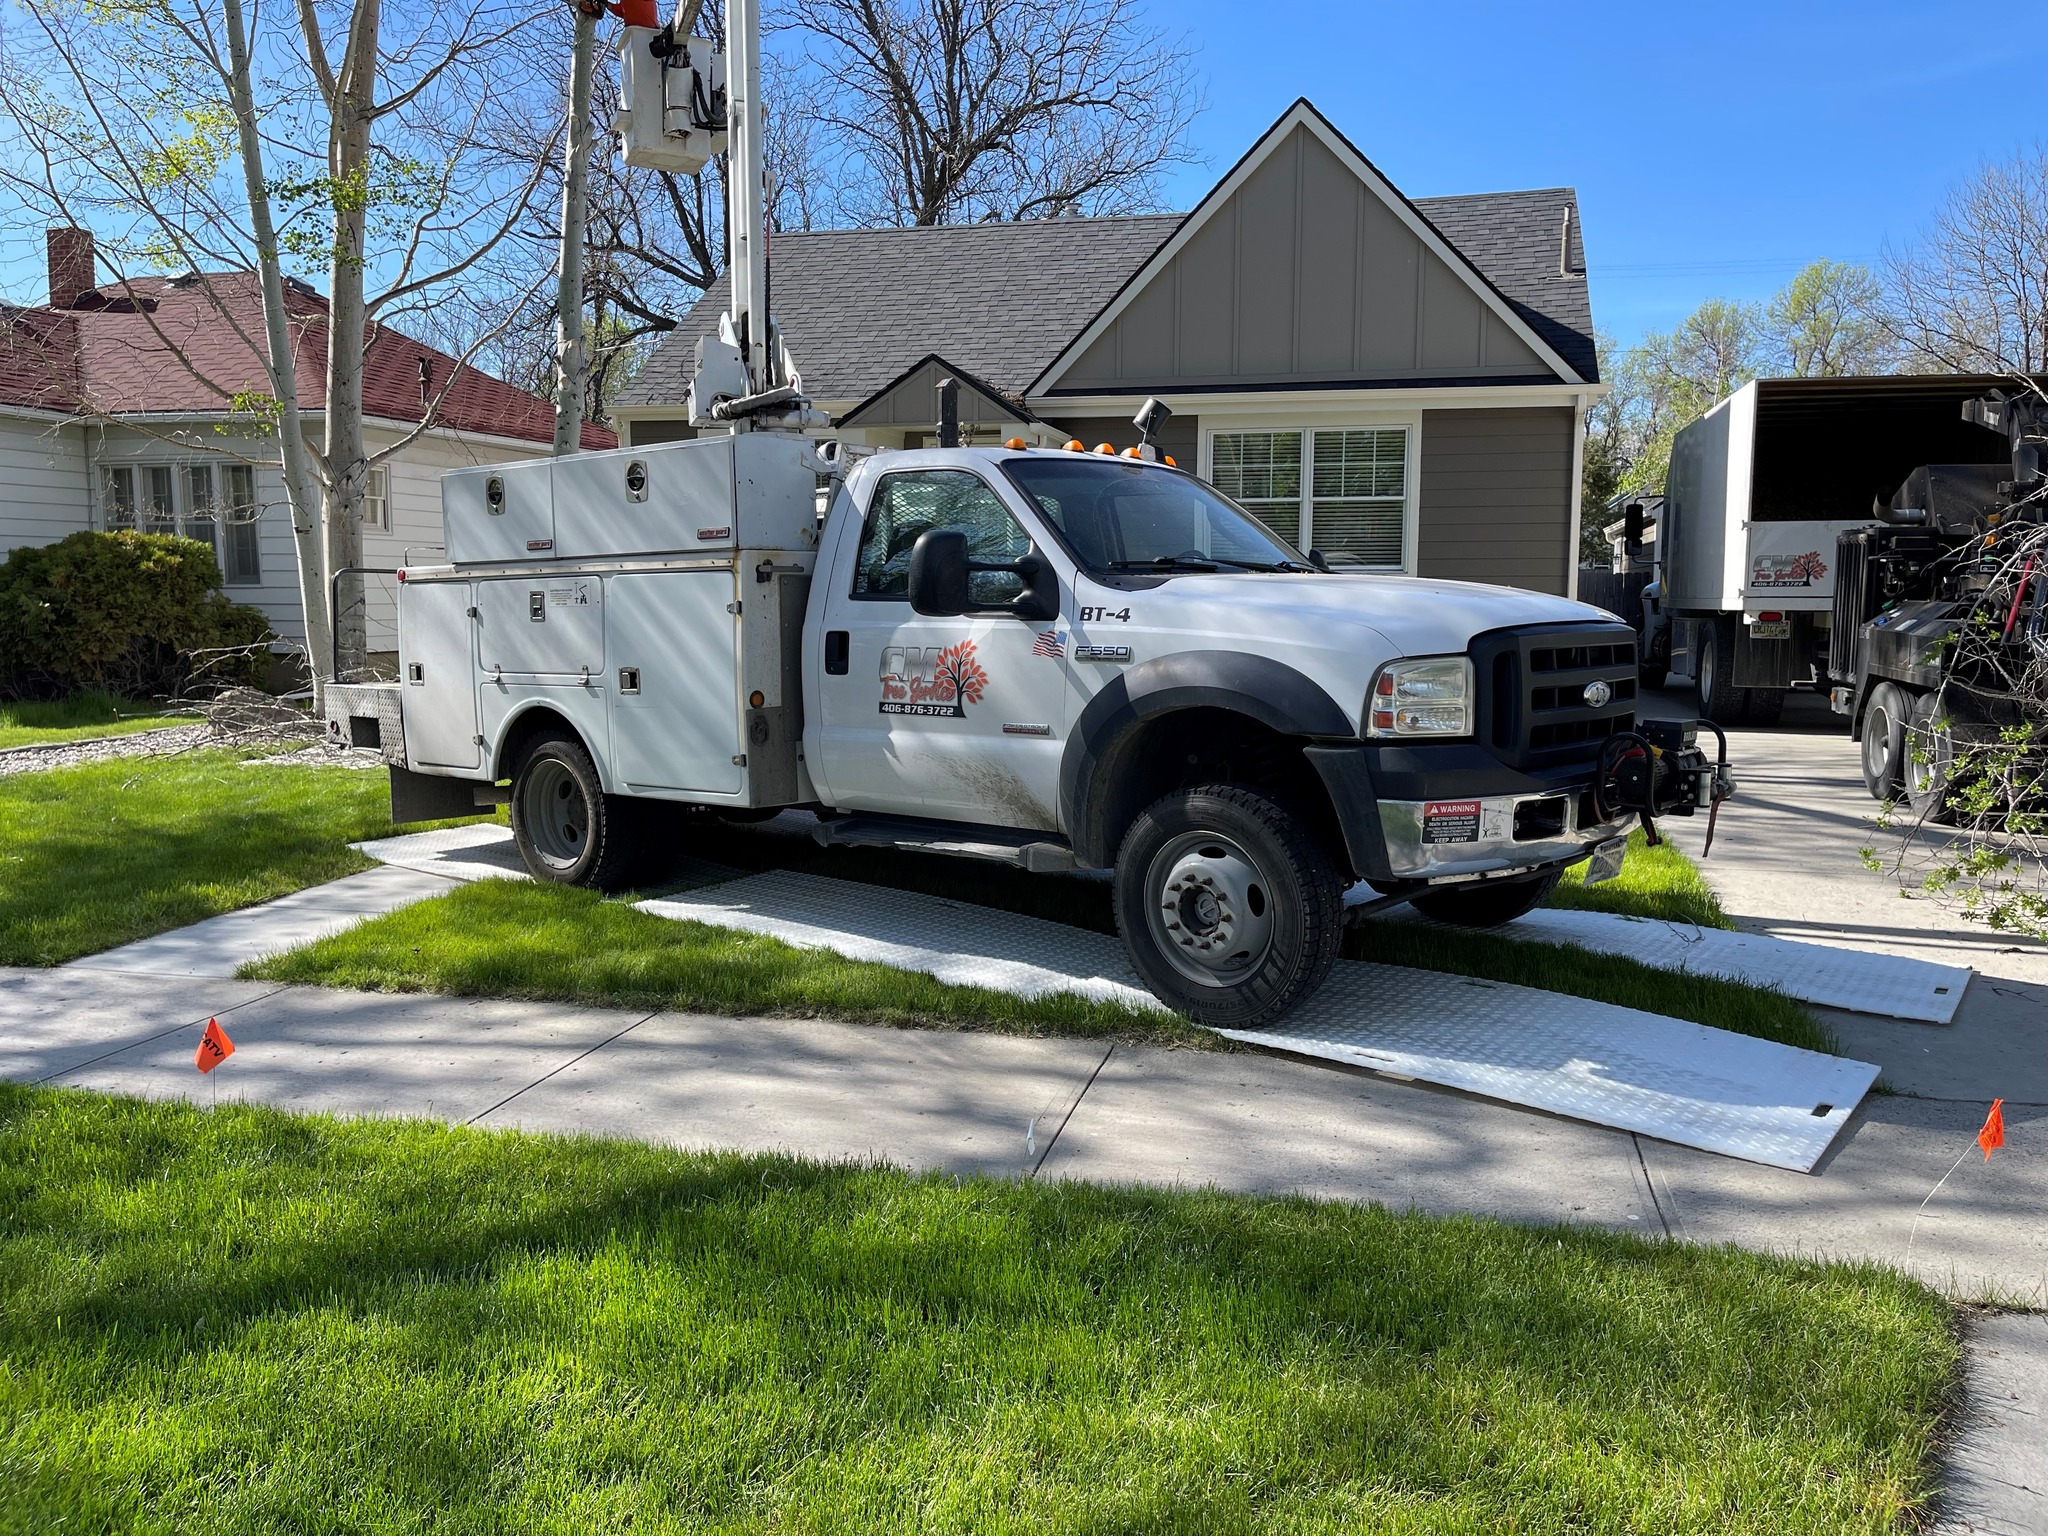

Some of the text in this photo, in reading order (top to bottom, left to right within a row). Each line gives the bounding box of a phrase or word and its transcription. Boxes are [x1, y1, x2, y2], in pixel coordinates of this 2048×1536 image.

[1753, 555, 1797, 572] CM
[1079, 606, 1131, 622] BT-4
[879, 647, 942, 682] CM
[881, 676, 957, 704] Tree Service
[882, 703, 954, 716] 406-876-3722
[1440, 805, 1475, 813] WARNING
